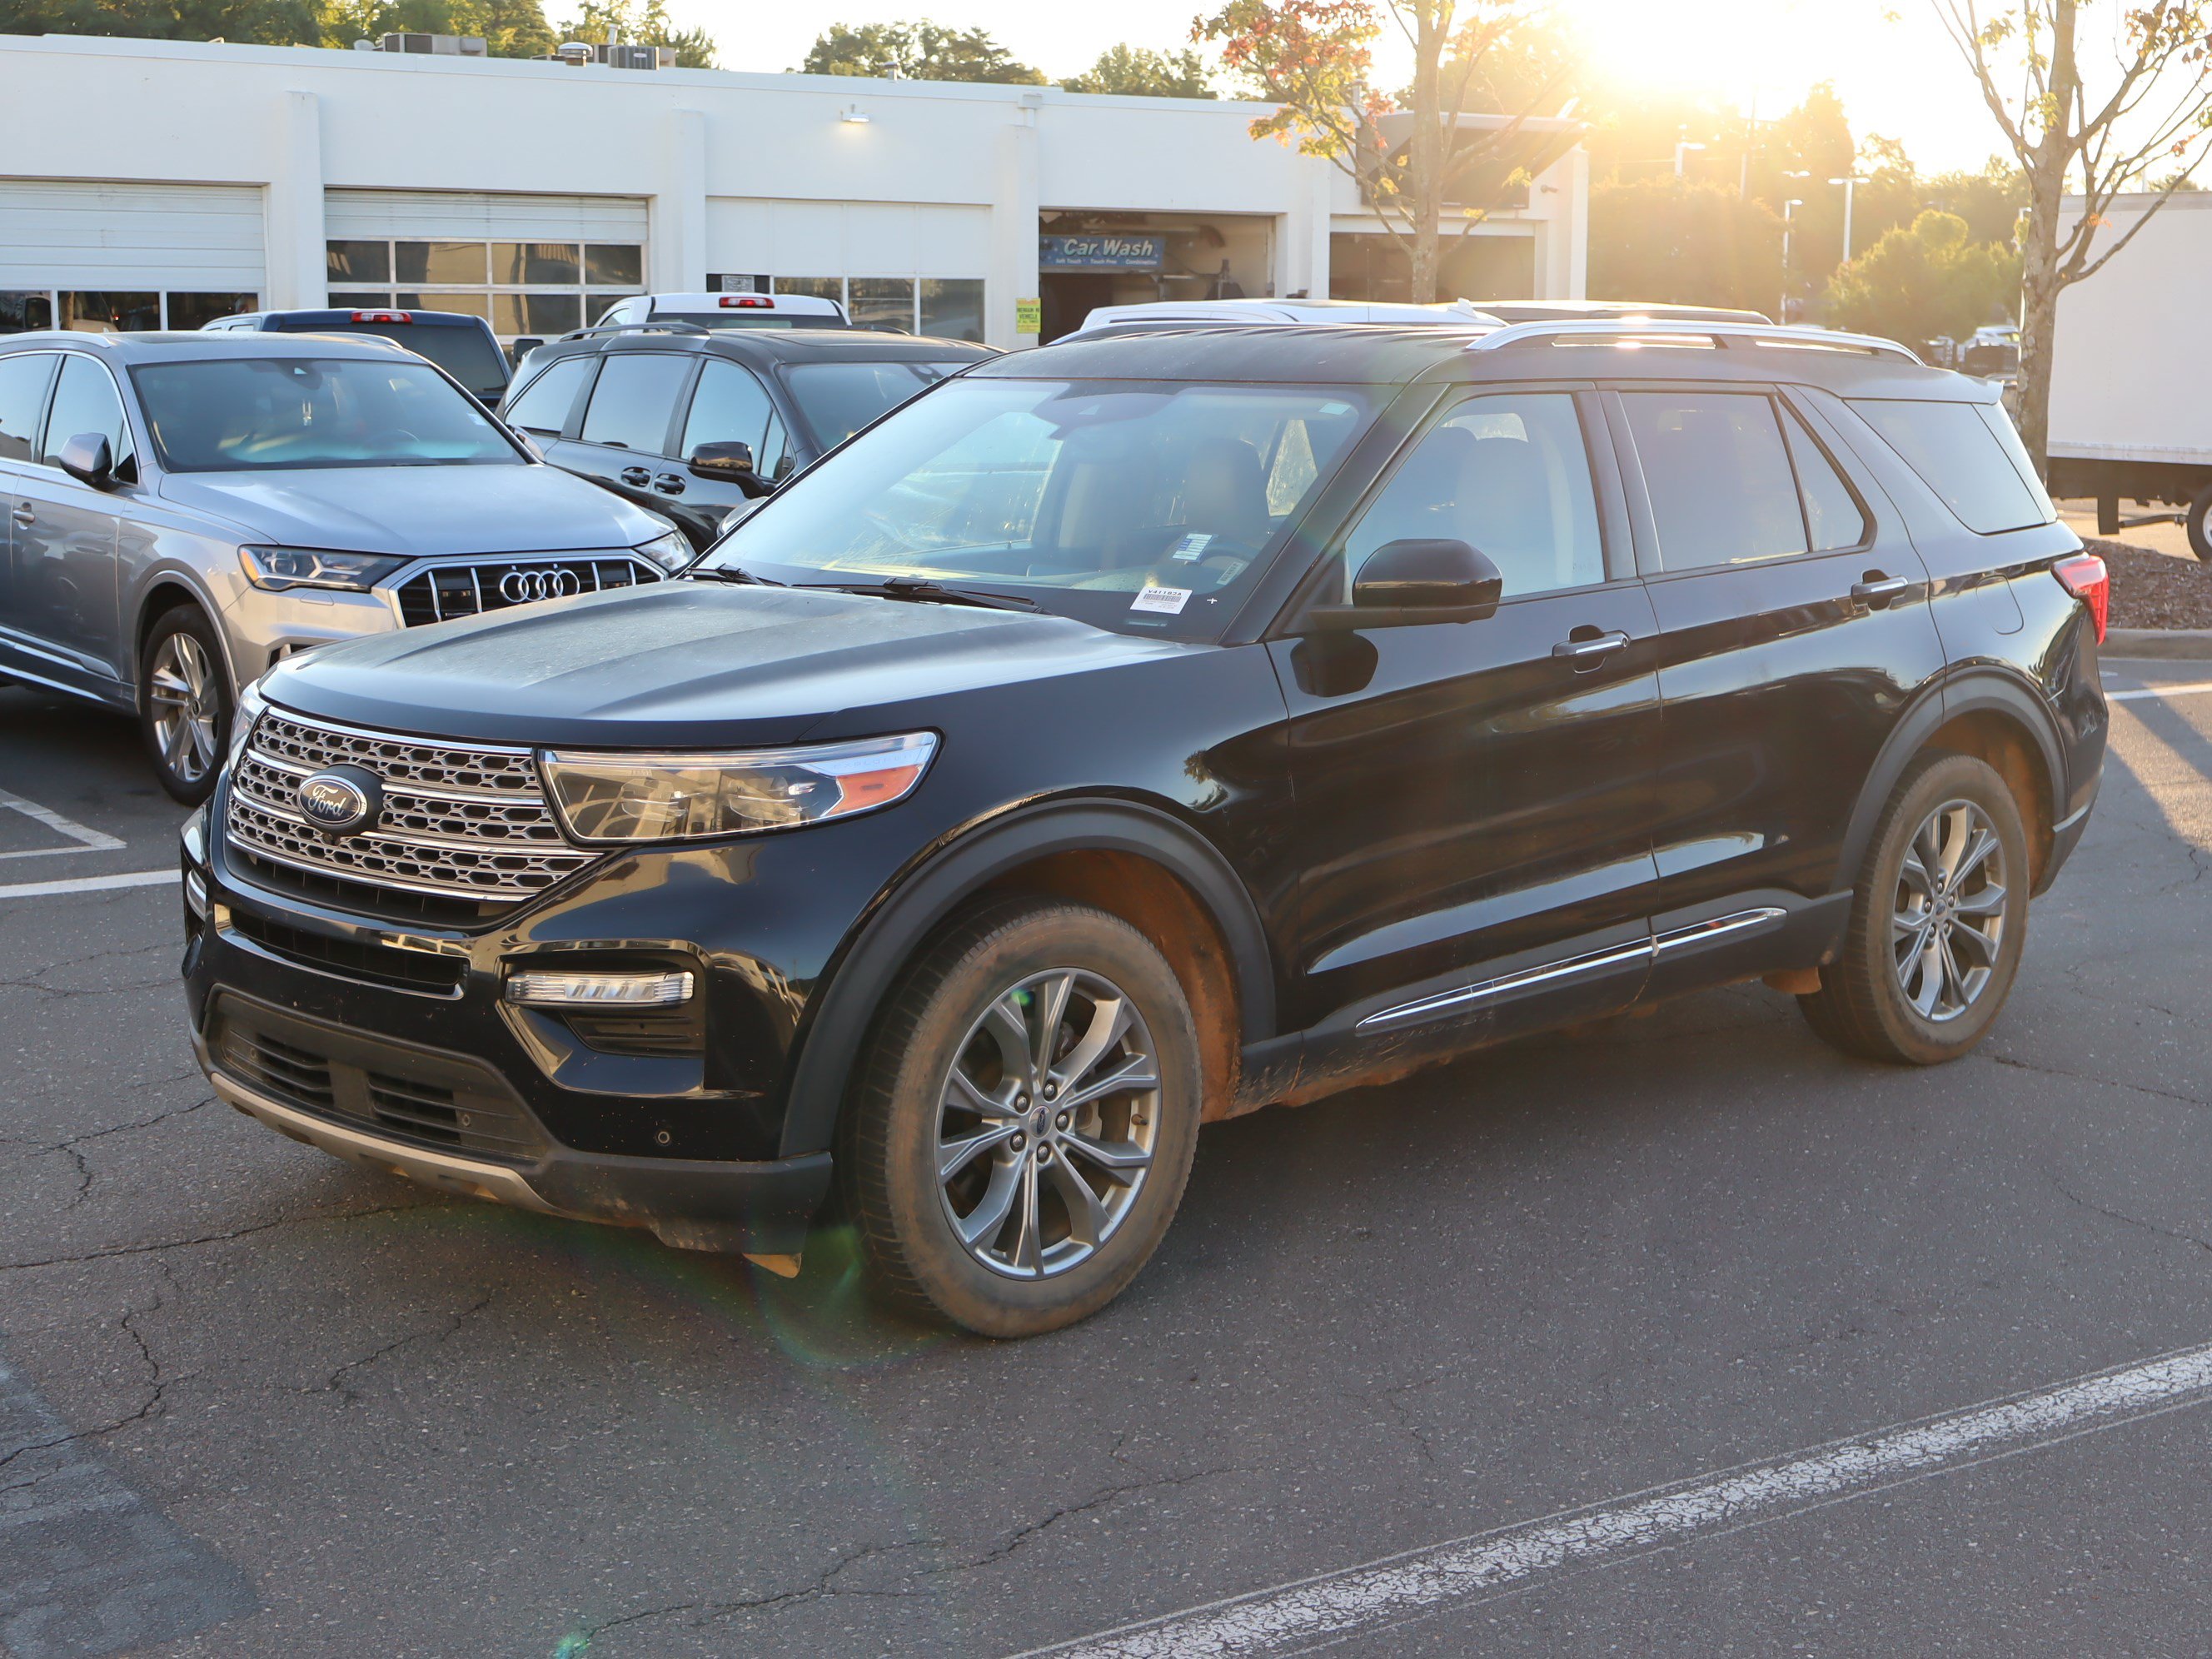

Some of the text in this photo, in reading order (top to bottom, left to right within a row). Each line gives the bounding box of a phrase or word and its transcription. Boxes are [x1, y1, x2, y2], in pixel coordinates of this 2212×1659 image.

[1064, 238, 1153, 257] Car Wash
[307, 784, 347, 817] Ford
